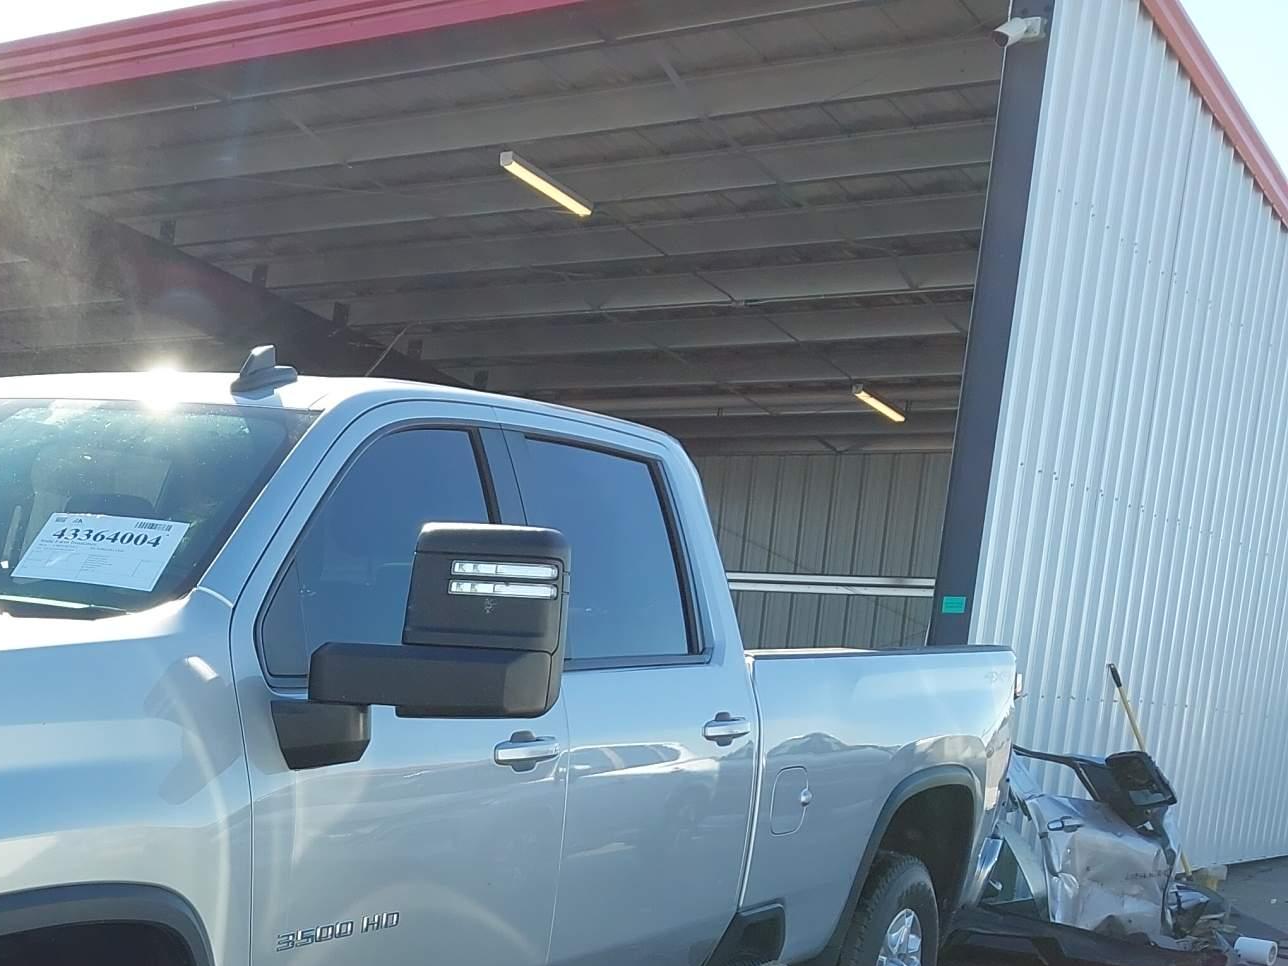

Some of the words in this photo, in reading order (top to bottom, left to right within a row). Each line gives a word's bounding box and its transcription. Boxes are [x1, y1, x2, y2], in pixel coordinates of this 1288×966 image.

[52, 527, 163, 549] 43364004
[276, 919, 354, 952] 3500
[360, 911, 401, 934] HD
